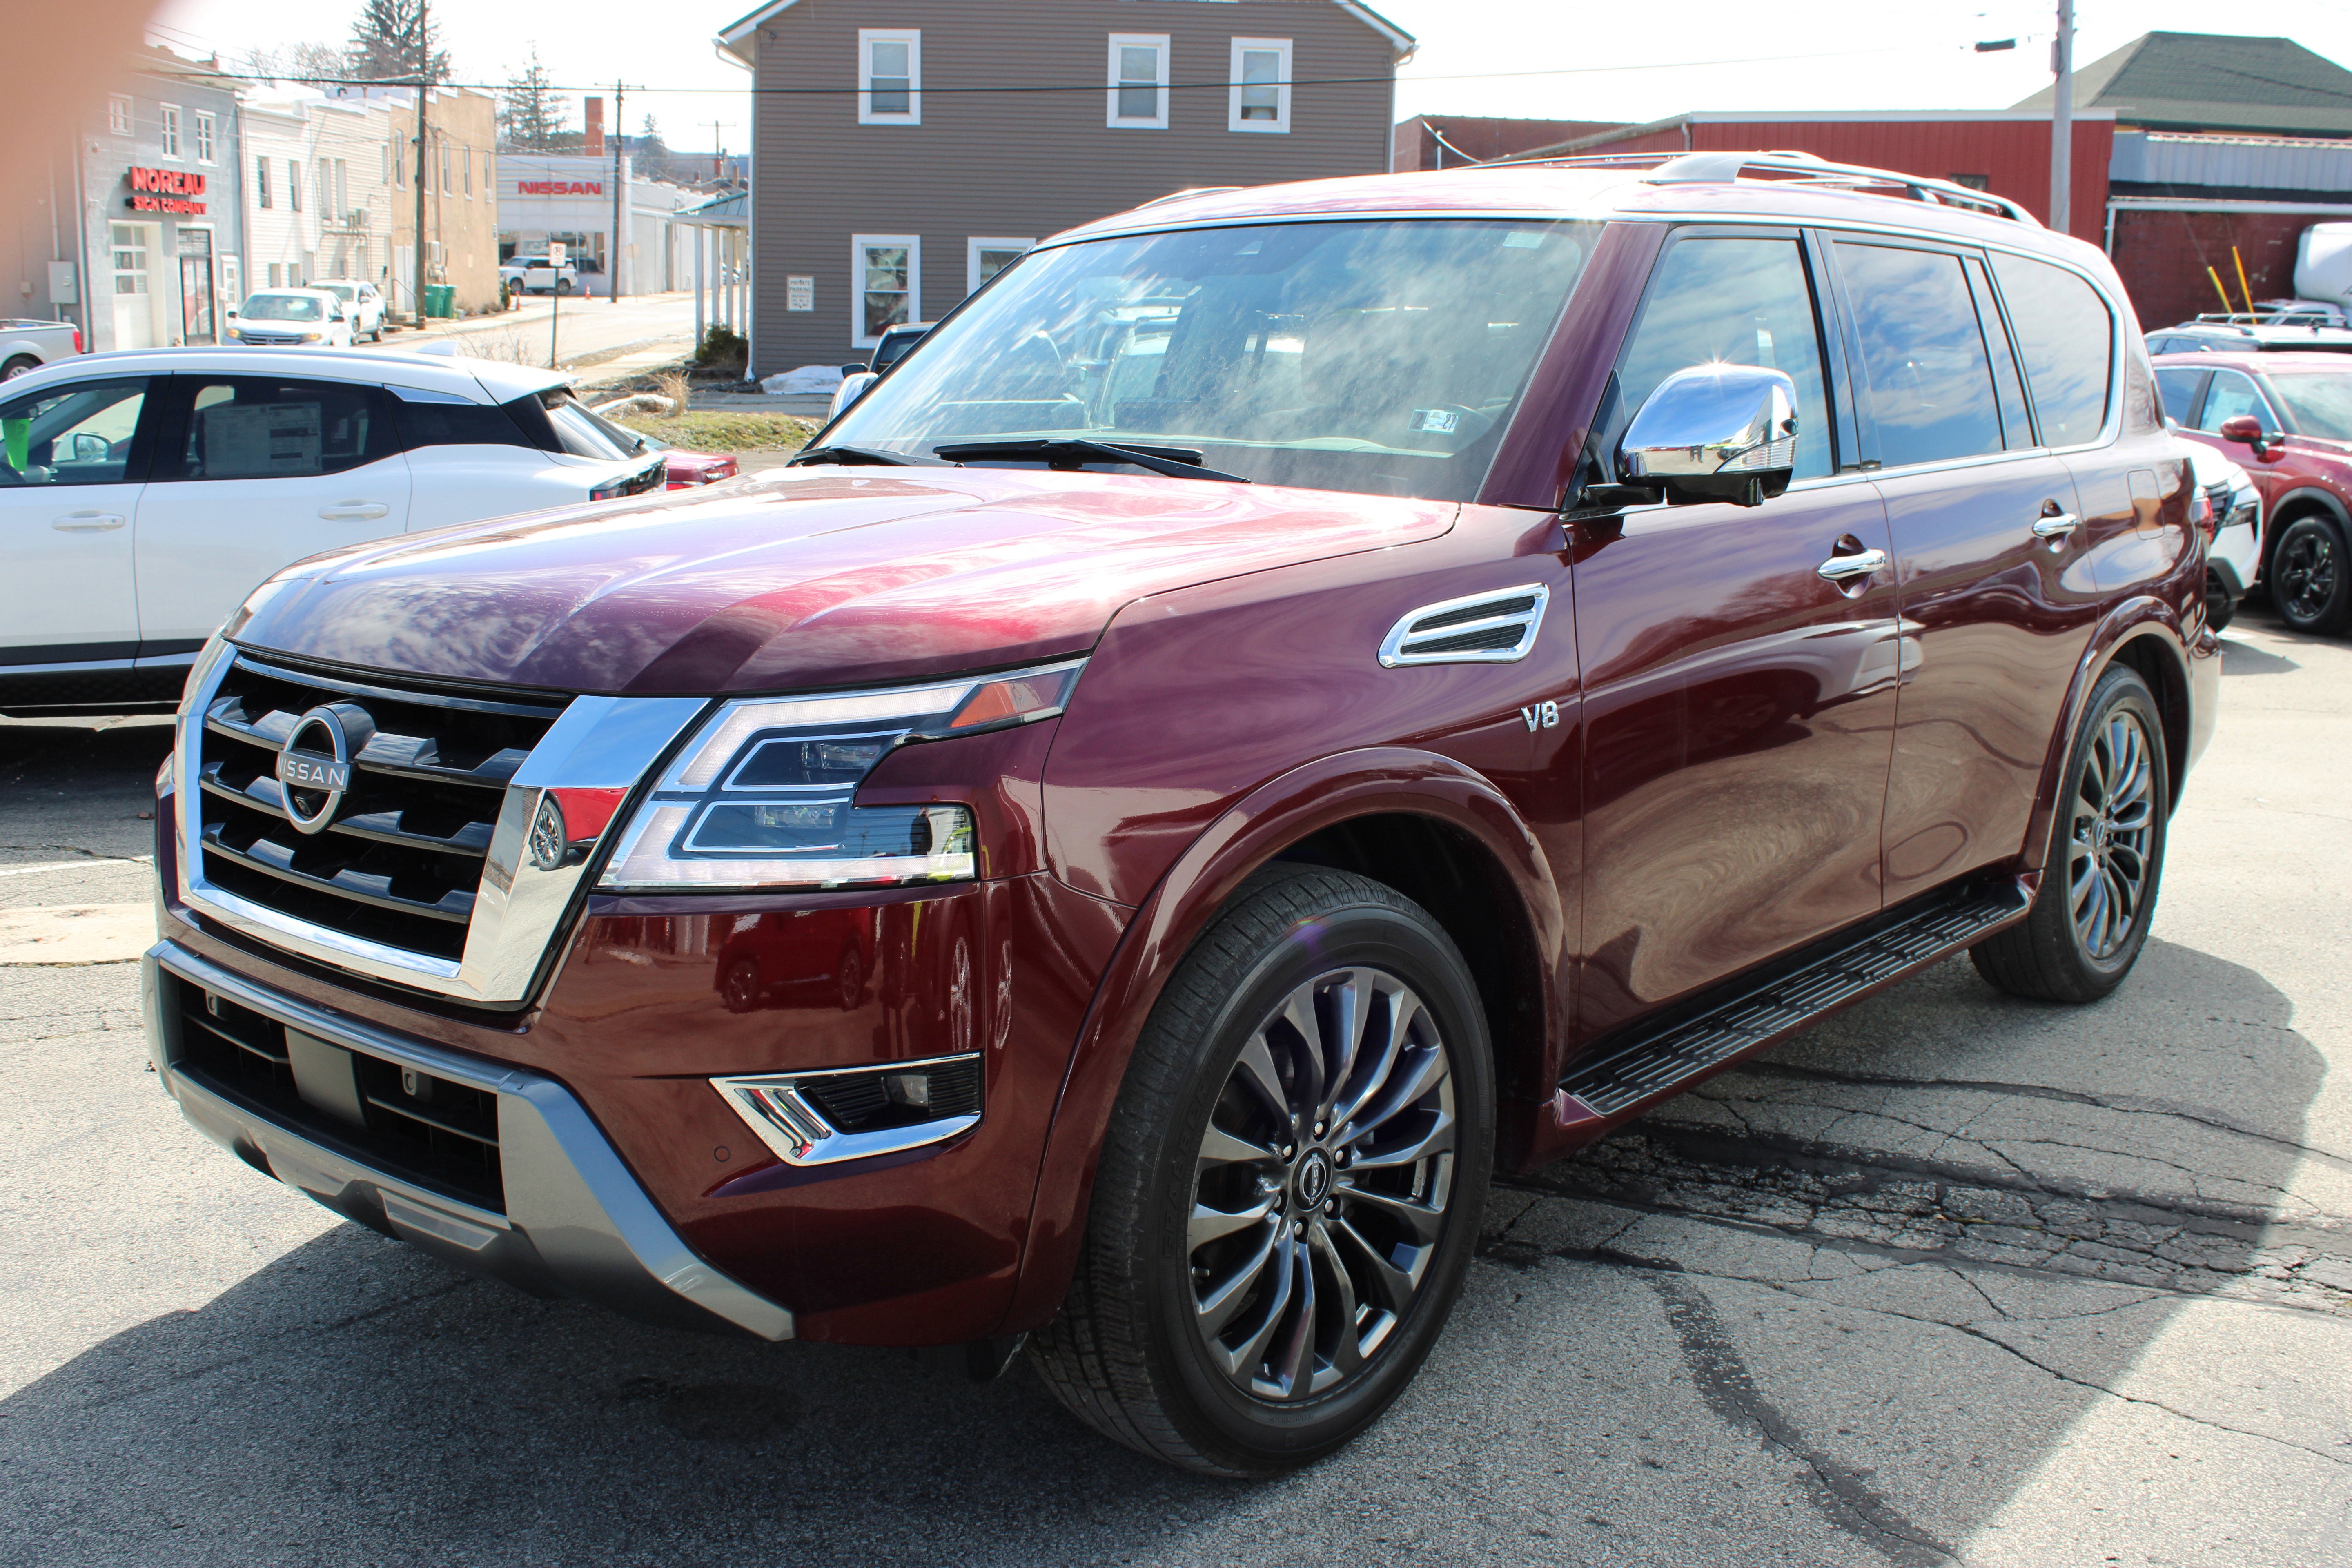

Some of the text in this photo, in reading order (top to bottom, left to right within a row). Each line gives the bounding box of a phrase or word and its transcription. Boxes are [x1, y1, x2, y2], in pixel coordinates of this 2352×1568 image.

[132, 167, 206, 196] MOREAU
[518, 181, 601, 194] NISSAN
[134, 195, 207, 215] SIGN COMPANY
[1442, 413, 1458, 431] 27
[1520, 700, 1559, 733] V8
[278, 756, 346, 786] NISSAN
[1309, 1154, 1319, 1205] NISSAN
